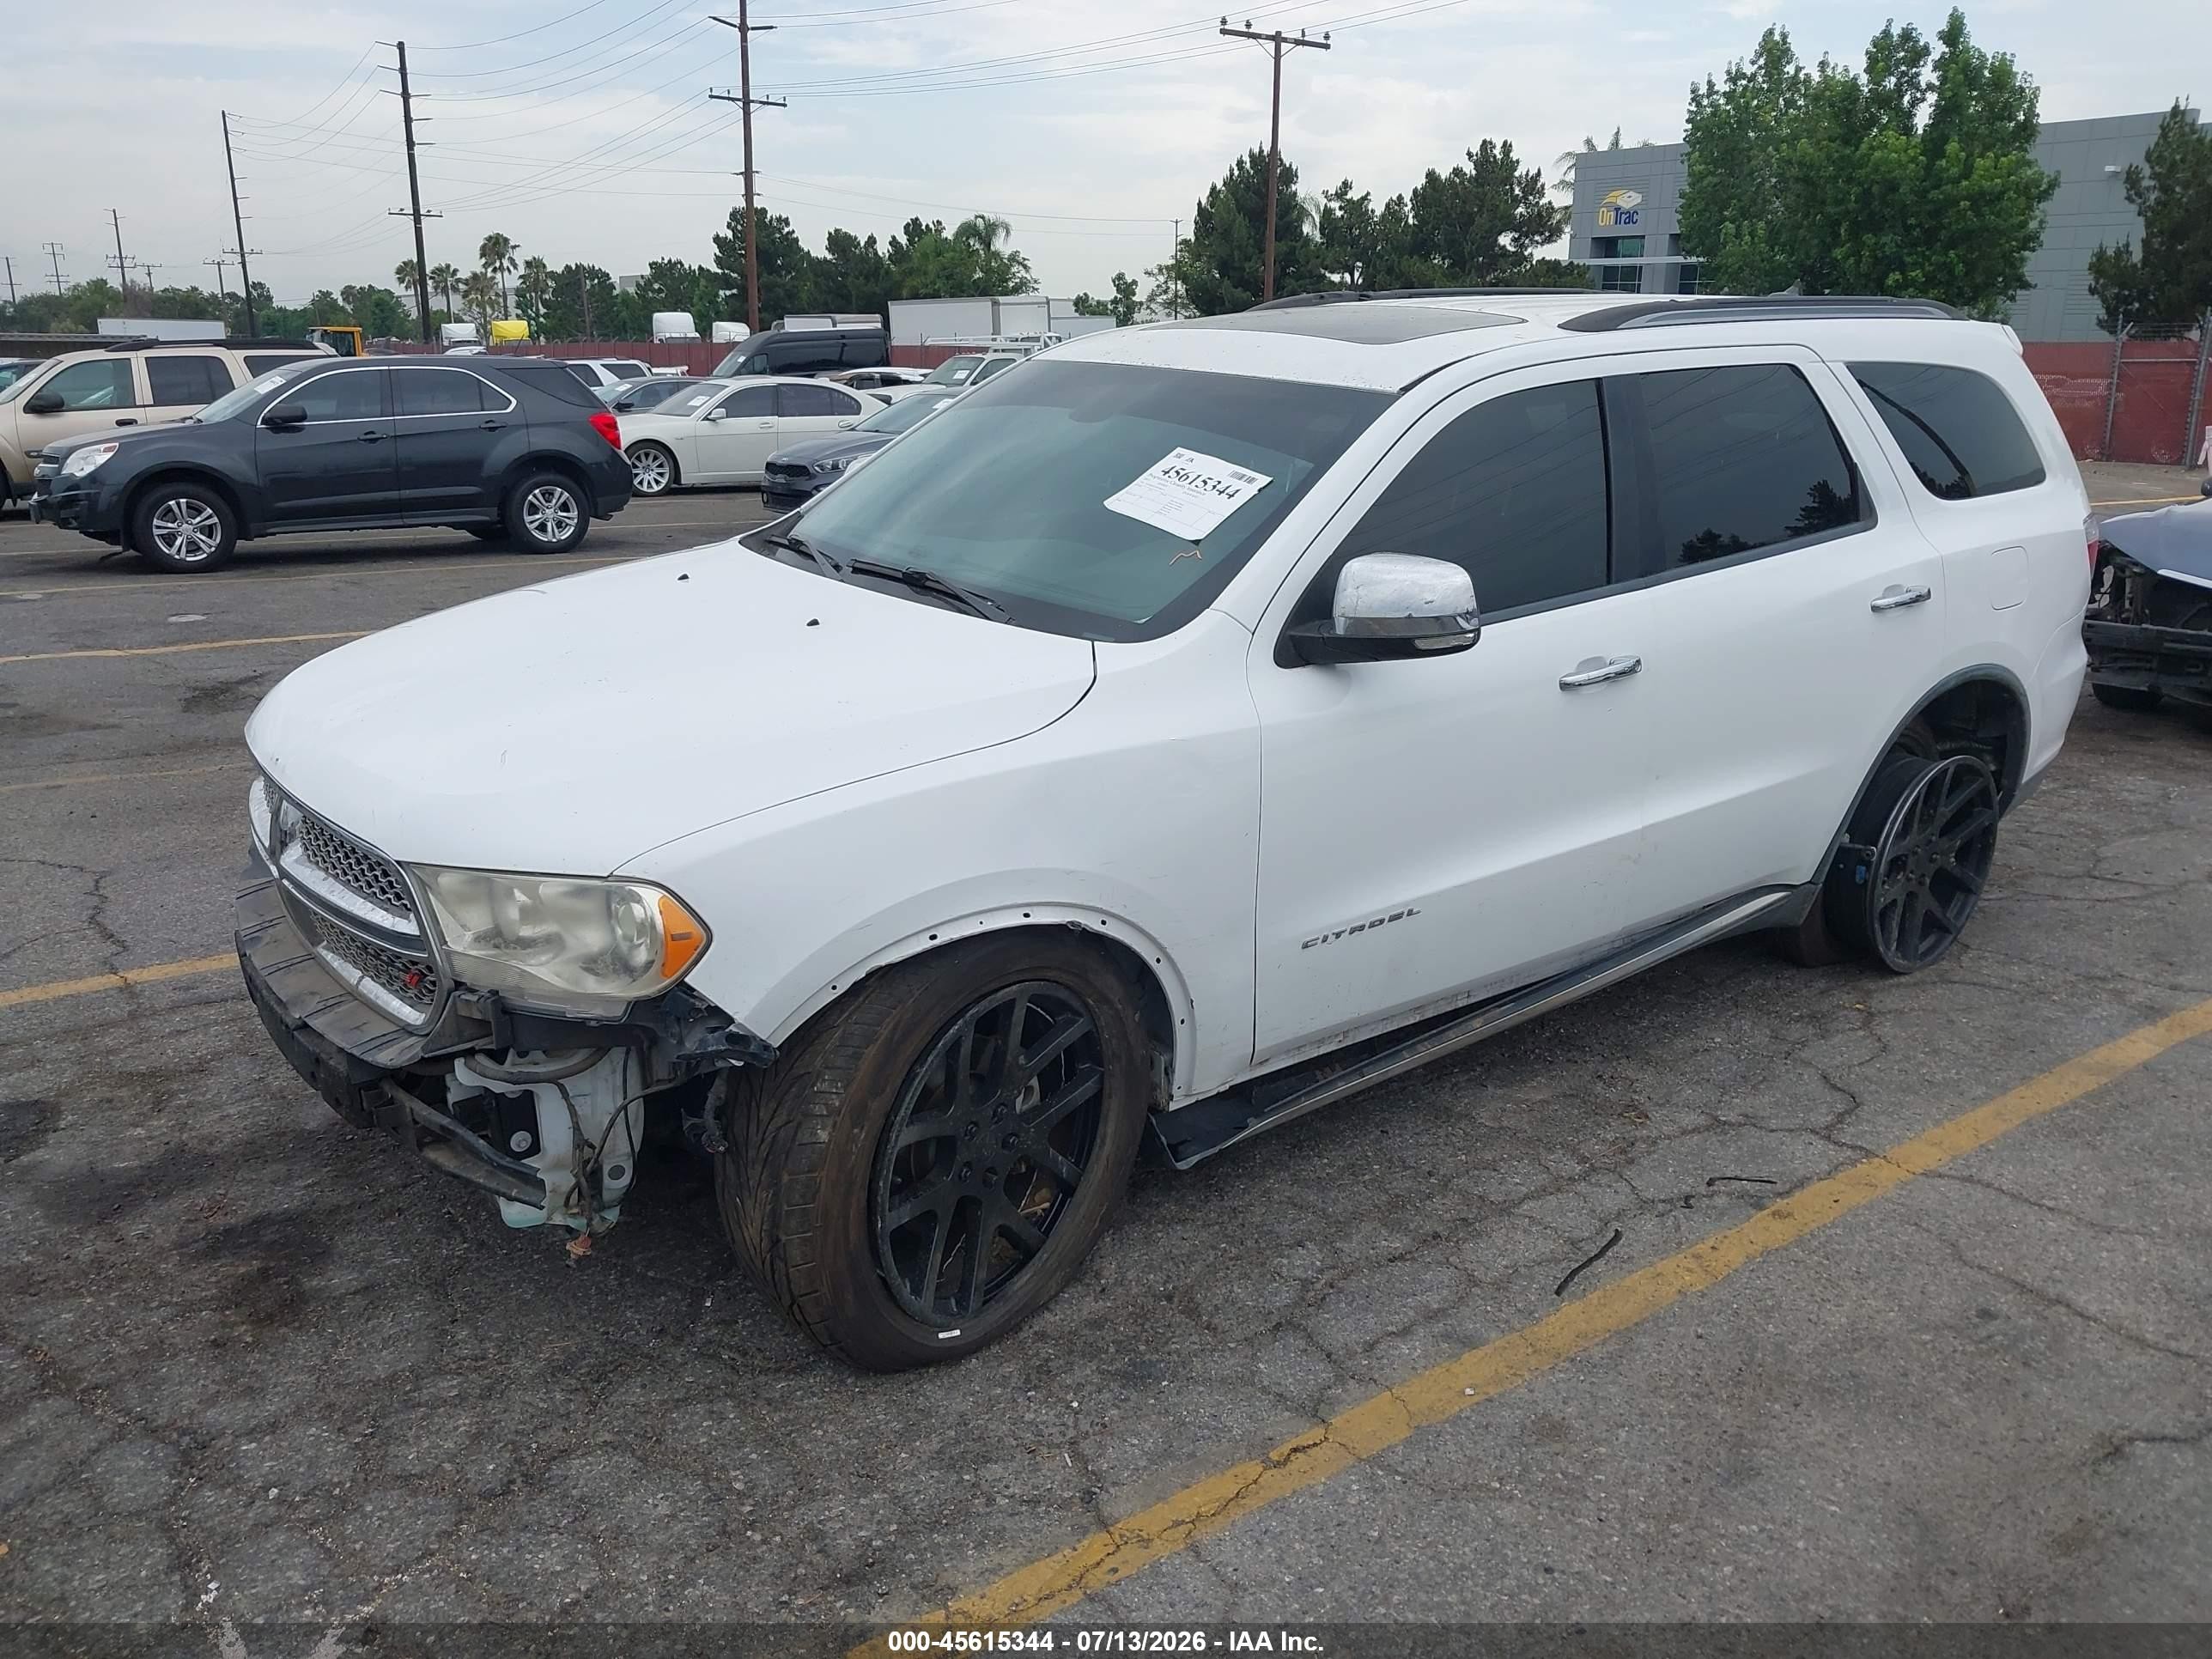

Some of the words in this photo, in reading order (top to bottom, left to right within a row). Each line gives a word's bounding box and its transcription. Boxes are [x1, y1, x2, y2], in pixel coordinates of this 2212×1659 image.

[1598, 207, 1639, 226] OnTrac
[1161, 465, 1243, 501] 45615344
[1301, 907, 1422, 950] CITADEL
